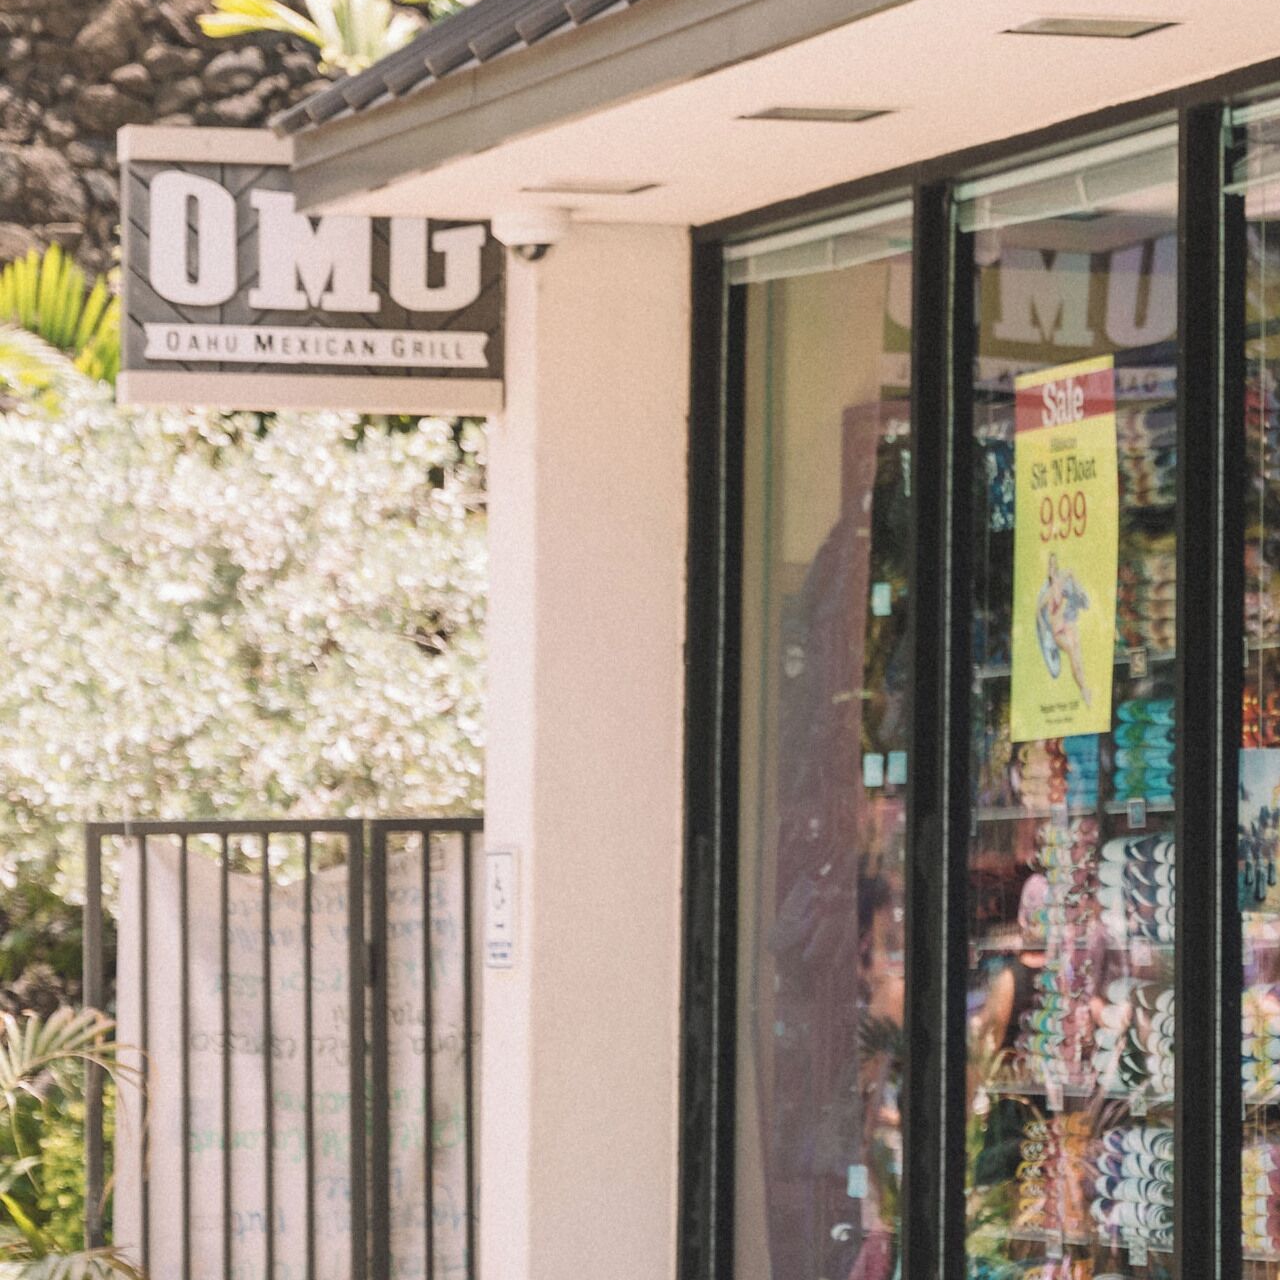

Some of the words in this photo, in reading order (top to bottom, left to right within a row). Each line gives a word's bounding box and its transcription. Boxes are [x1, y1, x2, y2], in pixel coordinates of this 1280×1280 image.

[149, 170, 487, 313] OMG
[166, 329, 239, 353] OAHU
[254, 332, 375, 357] MEXICAN
[391, 337, 466, 361] GRILL
[1041, 378, 1085, 428] Sale
[1031, 462, 1048, 490] Sit
[1066, 454, 1097, 485] Float
[1039, 490, 1088, 542] 9.99
